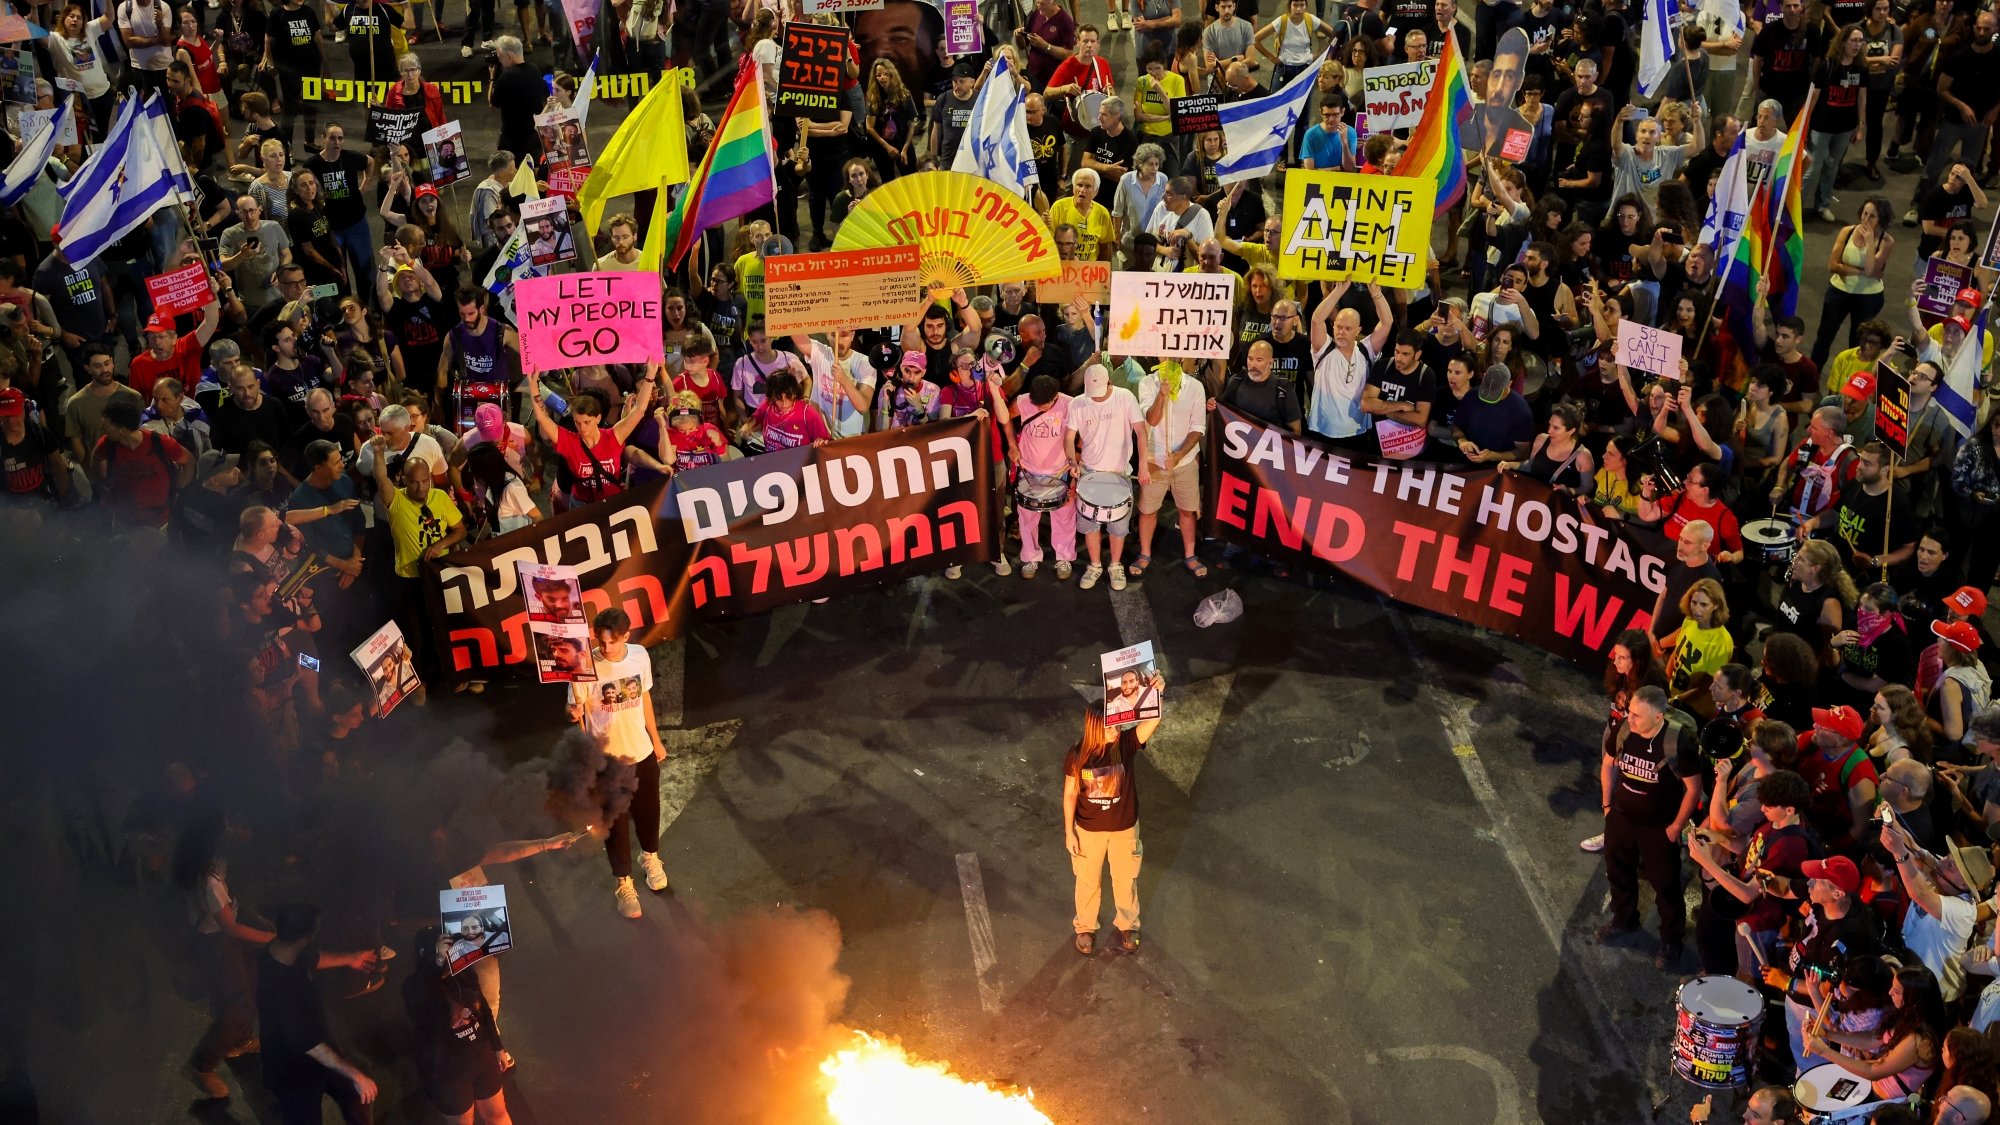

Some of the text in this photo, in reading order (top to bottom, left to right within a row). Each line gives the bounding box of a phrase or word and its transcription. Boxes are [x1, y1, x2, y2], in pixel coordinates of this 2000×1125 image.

[789, 34, 843, 62] ביבי
[785, 60, 839, 87] בוגד
[1178, 97, 1216, 108] החטופים
[1189, 104, 1218, 114] הביתה
[887, 206, 971, 246] בוערת
[971, 186, 1047, 263] אדמתי
[1302, 216, 1396, 246] THEM
[769, 252, 915, 276] בית בעזה הכי זול בארץ!
[1301, 248, 1410, 283] HME!
[152, 266, 203, 288] END THE WAR
[168, 280, 194, 291] BRING
[558, 276, 622, 299] LET
[158, 283, 207, 303] ALL OF THEM
[173, 295, 199, 308] HOME
[1145, 279, 1230, 301] הממשלה
[527, 300, 658, 330] MY PEOPLE
[1156, 308, 1228, 326] הורגת
[557, 327, 620, 358] GO
[1161, 333, 1224, 351] אותנו
[1640, 327, 1658, 344] 58
[1627, 337, 1671, 360] CAN'T
[1628, 351, 1667, 374] WAIT
[1223, 420, 1667, 595] SAVE THE HOSTAG
[440, 435, 976, 614] החטופים הביתה
[1216, 471, 1653, 659] END THE WA
[449, 499, 982, 671] הממשלה התה
